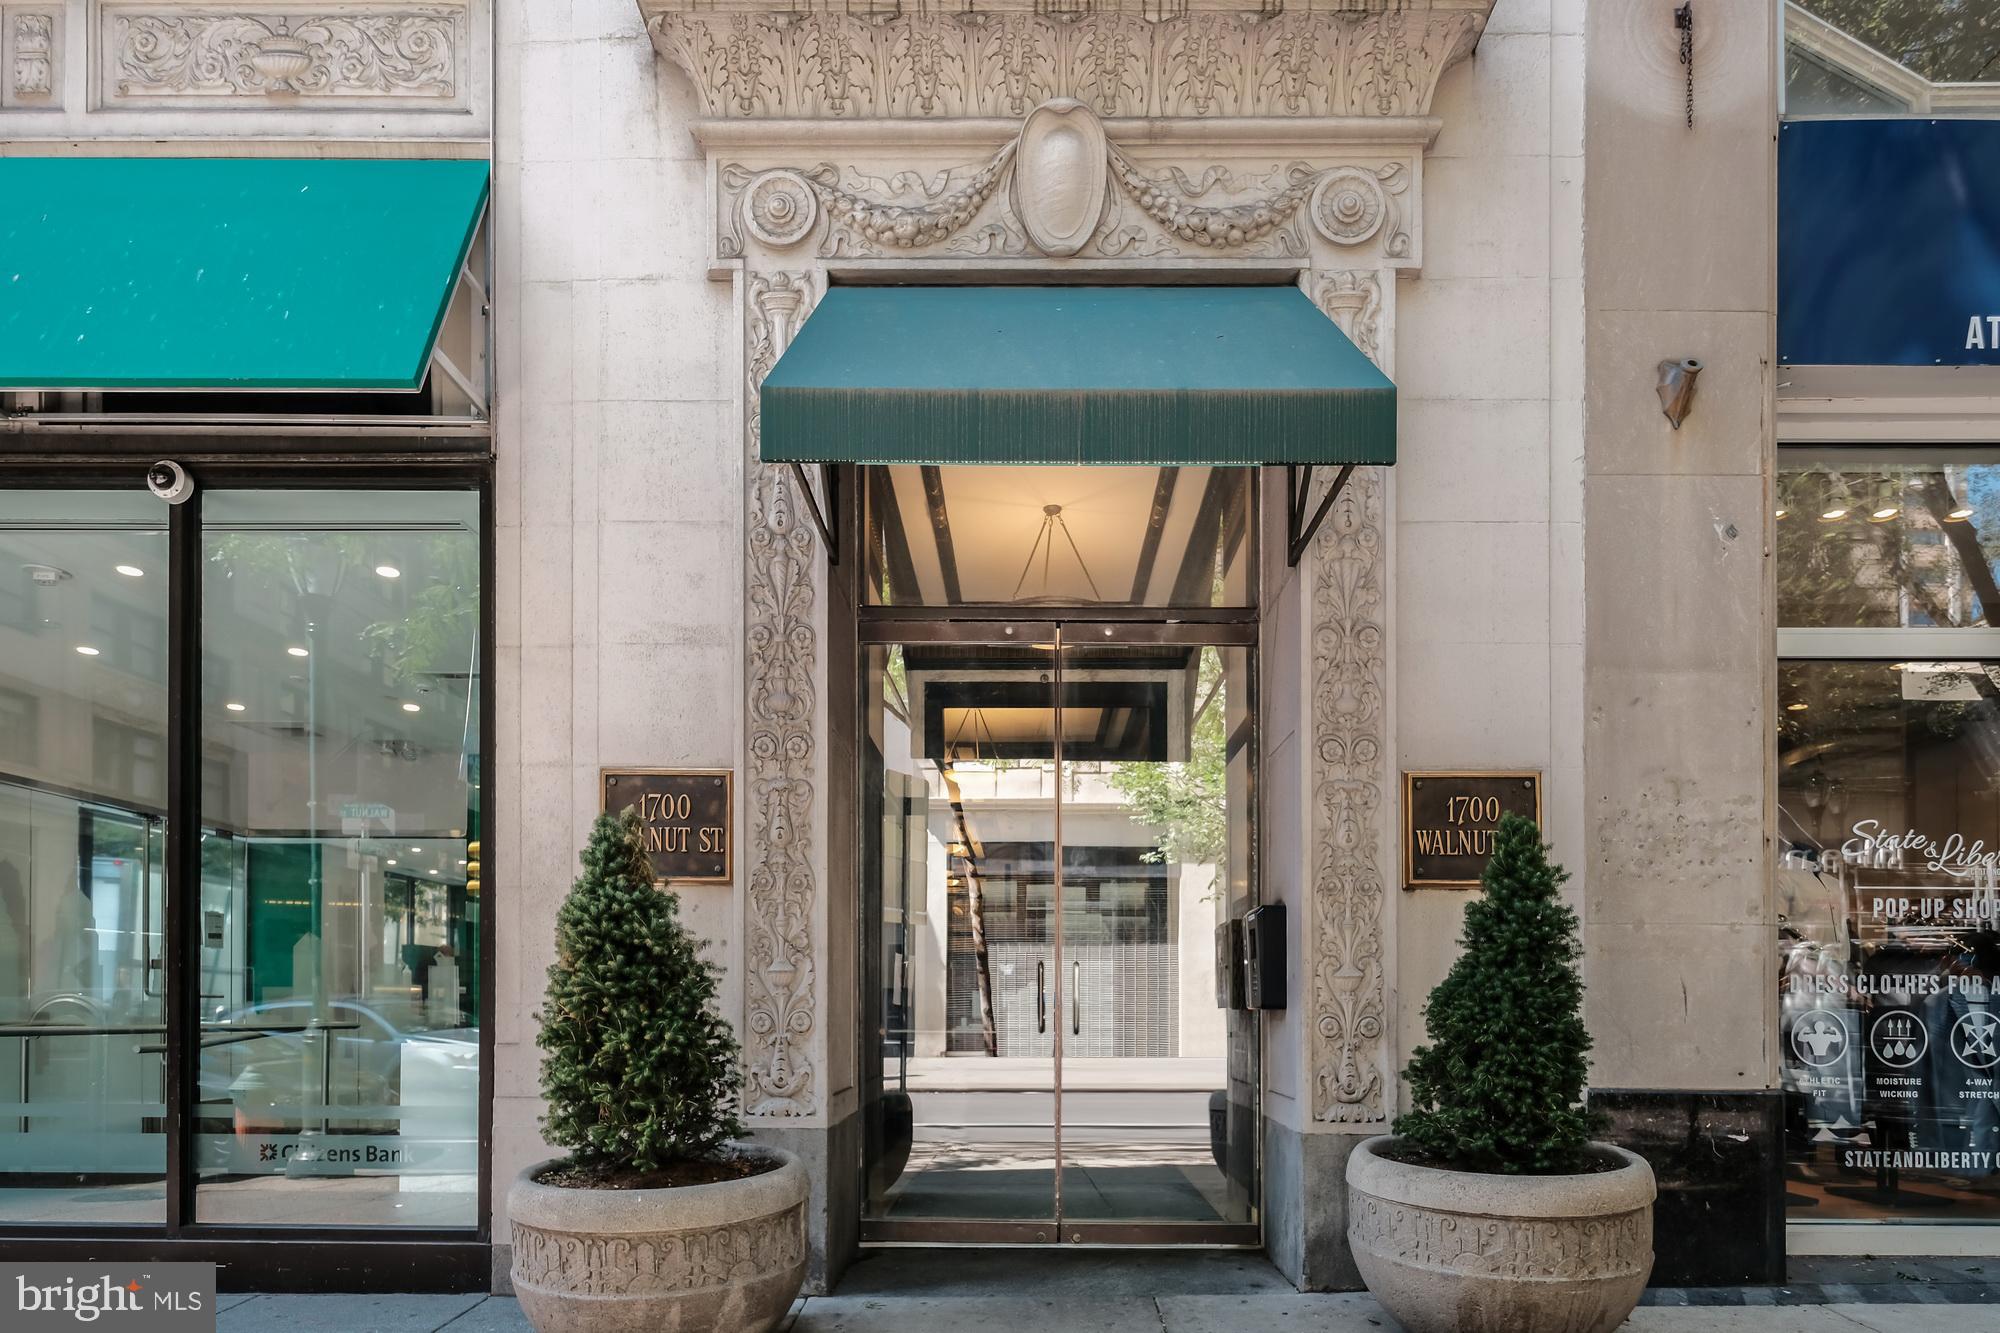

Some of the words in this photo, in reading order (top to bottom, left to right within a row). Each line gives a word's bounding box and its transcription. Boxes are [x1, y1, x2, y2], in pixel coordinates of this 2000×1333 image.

[1965, 315, 2000, 350] AT
[638, 793, 692, 823] 1700
[1446, 796, 1500, 826] 1700
[699, 827, 724, 853] ST.
[1415, 830, 1499, 856] WALNUT
[1841, 819, 1929, 857] State
[1924, 840, 1941, 859] &
[1873, 897, 1945, 919] POP-UP
[1953, 897, 2000, 919] SHOP
[1790, 974, 1849, 995] DRESS
[1857, 974, 1940, 996] CLOTHES
[1948, 975, 1985, 995] FOR
[1876, 1077, 1922, 1087] MOISTURE
[1966, 1078, 1993, 1087] 4-WAY
[1812, 1089, 1827, 1098] FIT
[1880, 1090, 1919, 1099] WICKING
[1958, 1091, 2000, 1100] STRETCH
[281, 1143, 361, 1162] Czens
[366, 1144, 414, 1163] Bank
